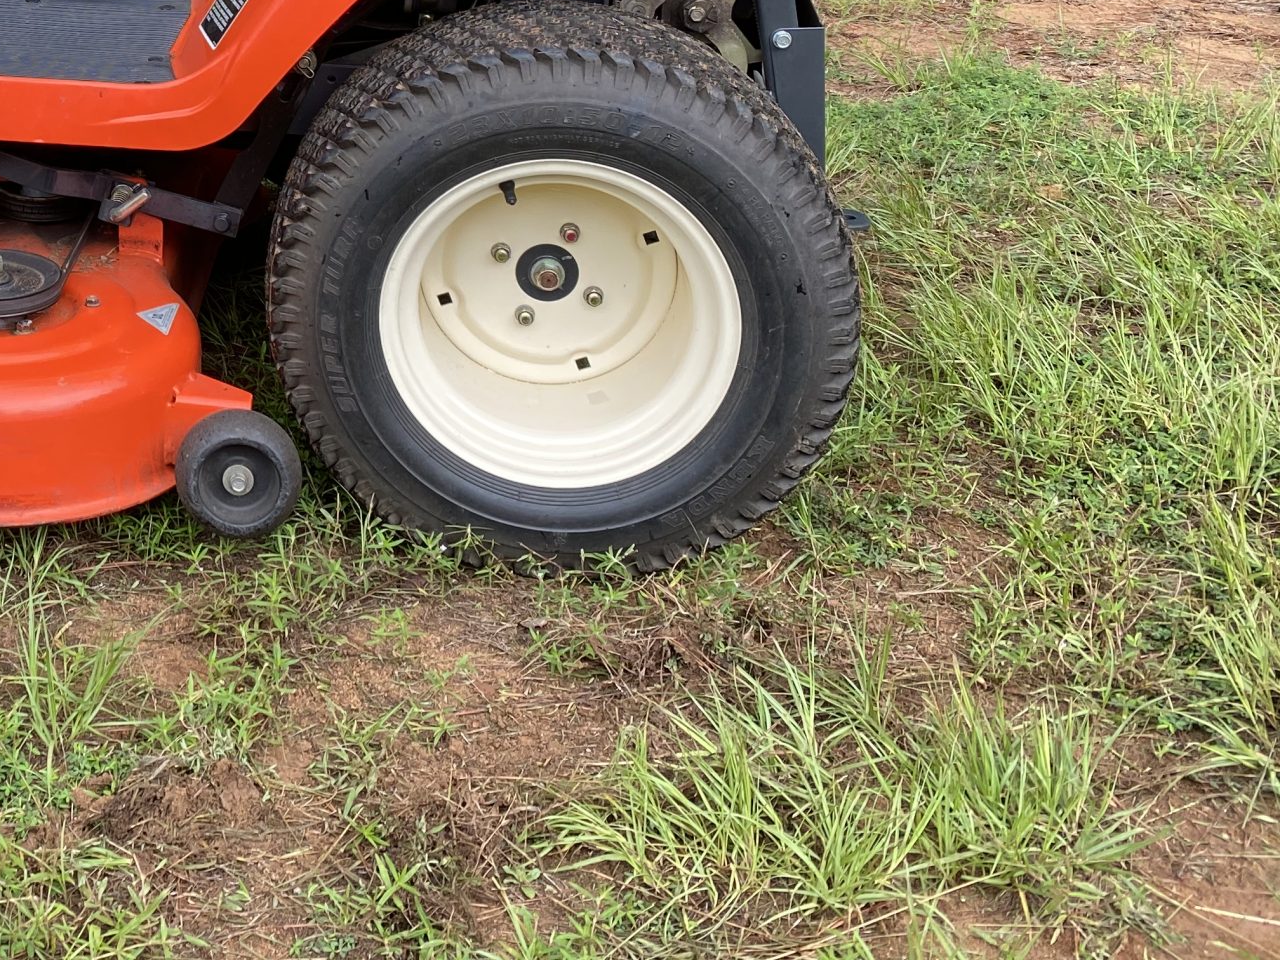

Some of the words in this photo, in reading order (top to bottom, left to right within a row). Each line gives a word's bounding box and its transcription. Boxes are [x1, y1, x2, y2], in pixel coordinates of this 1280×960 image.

[322, 215, 363, 296] TURF
[320, 311, 359, 413] SUPER
[660, 433, 777, 529] KENDA
